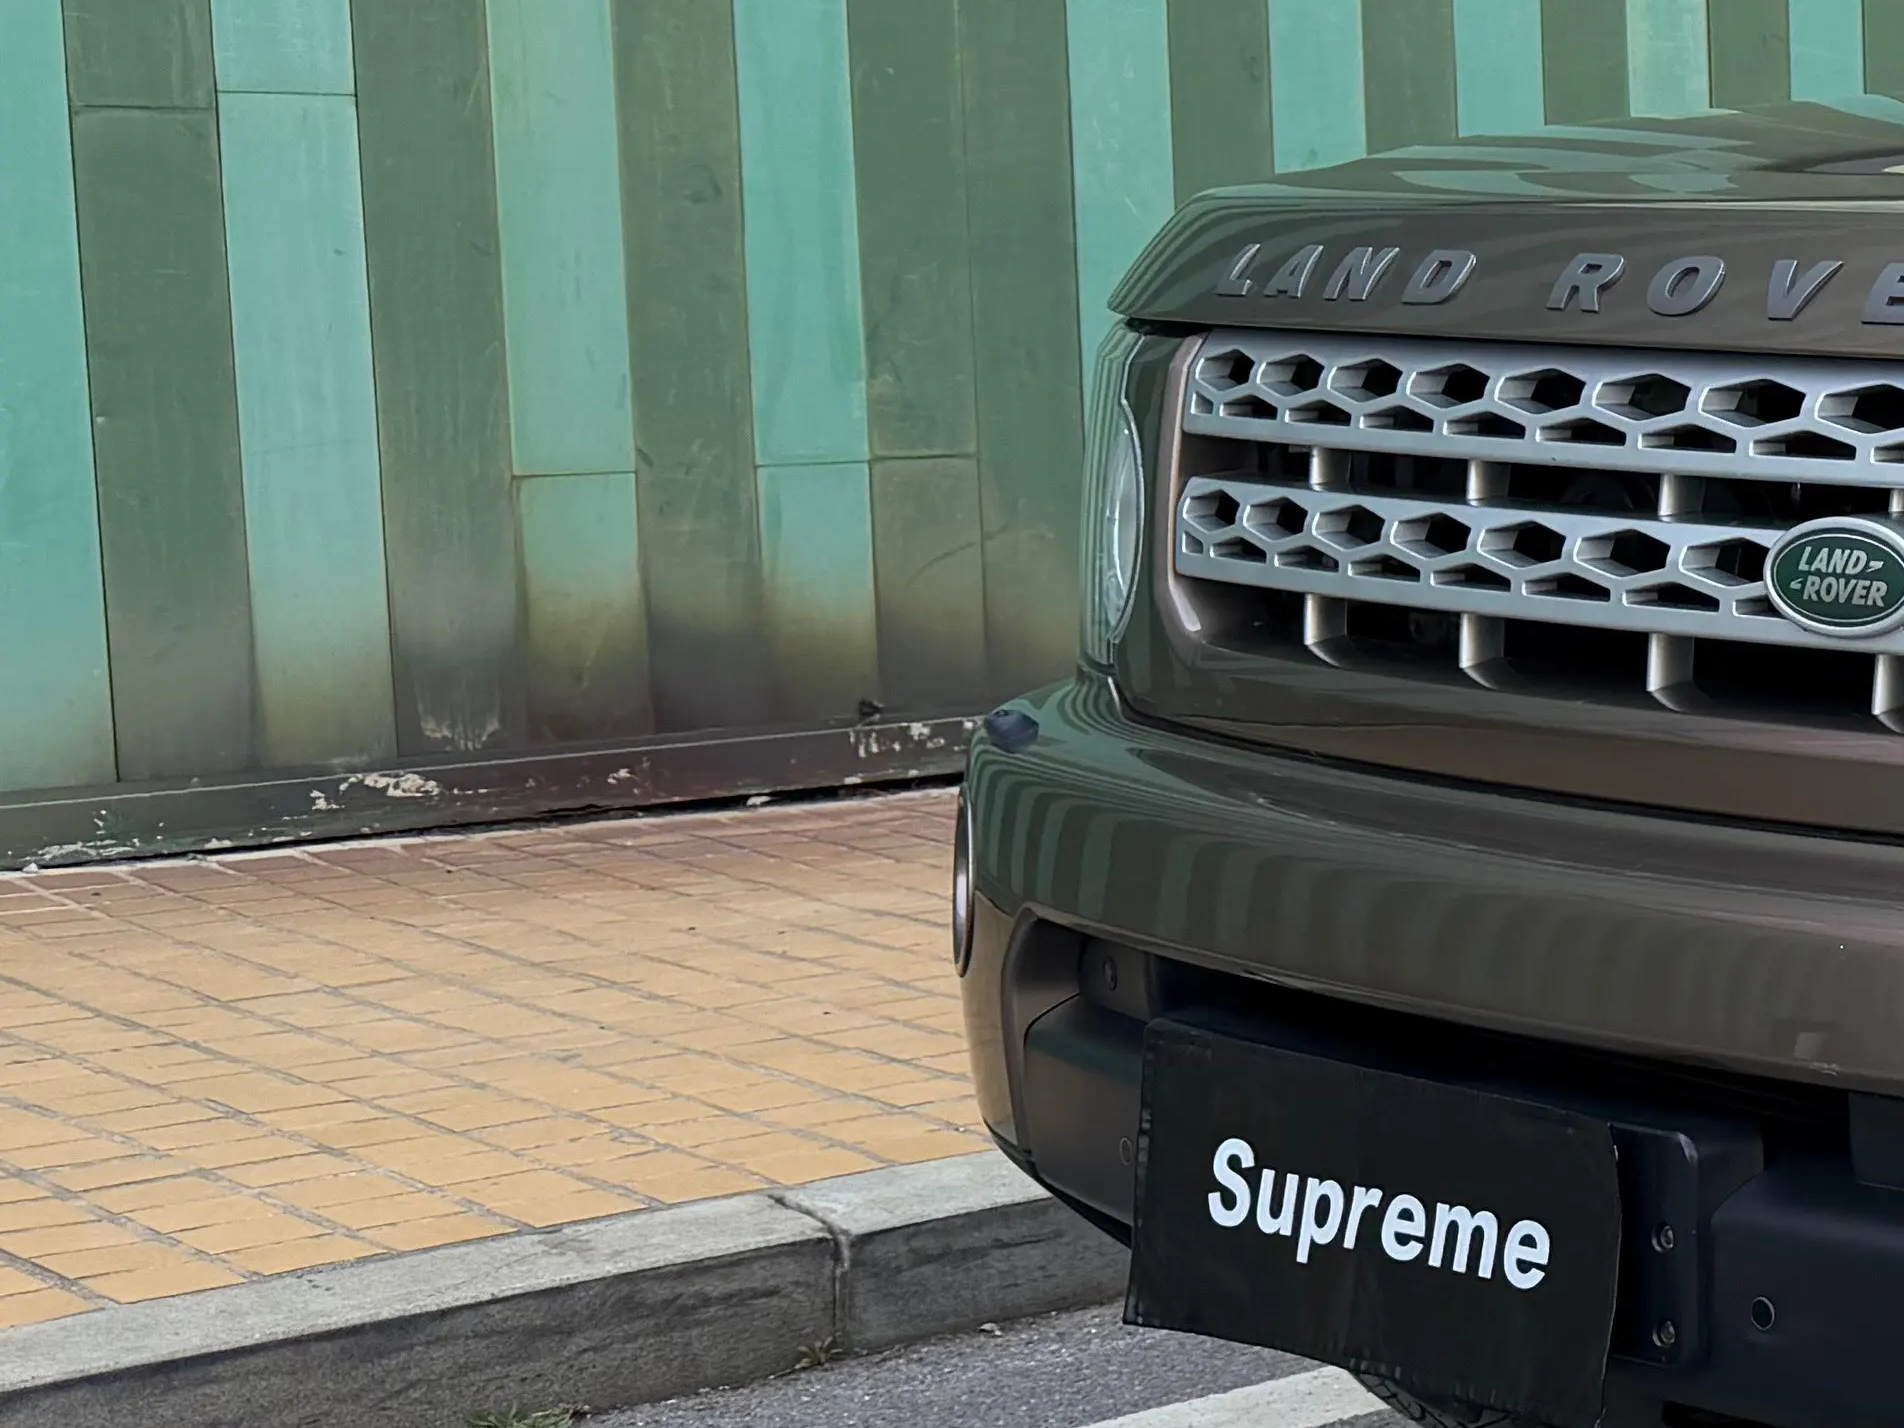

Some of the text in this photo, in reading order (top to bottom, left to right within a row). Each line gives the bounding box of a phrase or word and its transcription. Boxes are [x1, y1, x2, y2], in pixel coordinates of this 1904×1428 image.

[1214, 243, 1478, 306] LAND
[1797, 546, 1868, 575] LAND
[1802, 575, 1888, 608] ROVER
[1207, 1137, 1552, 1290] Supreme
